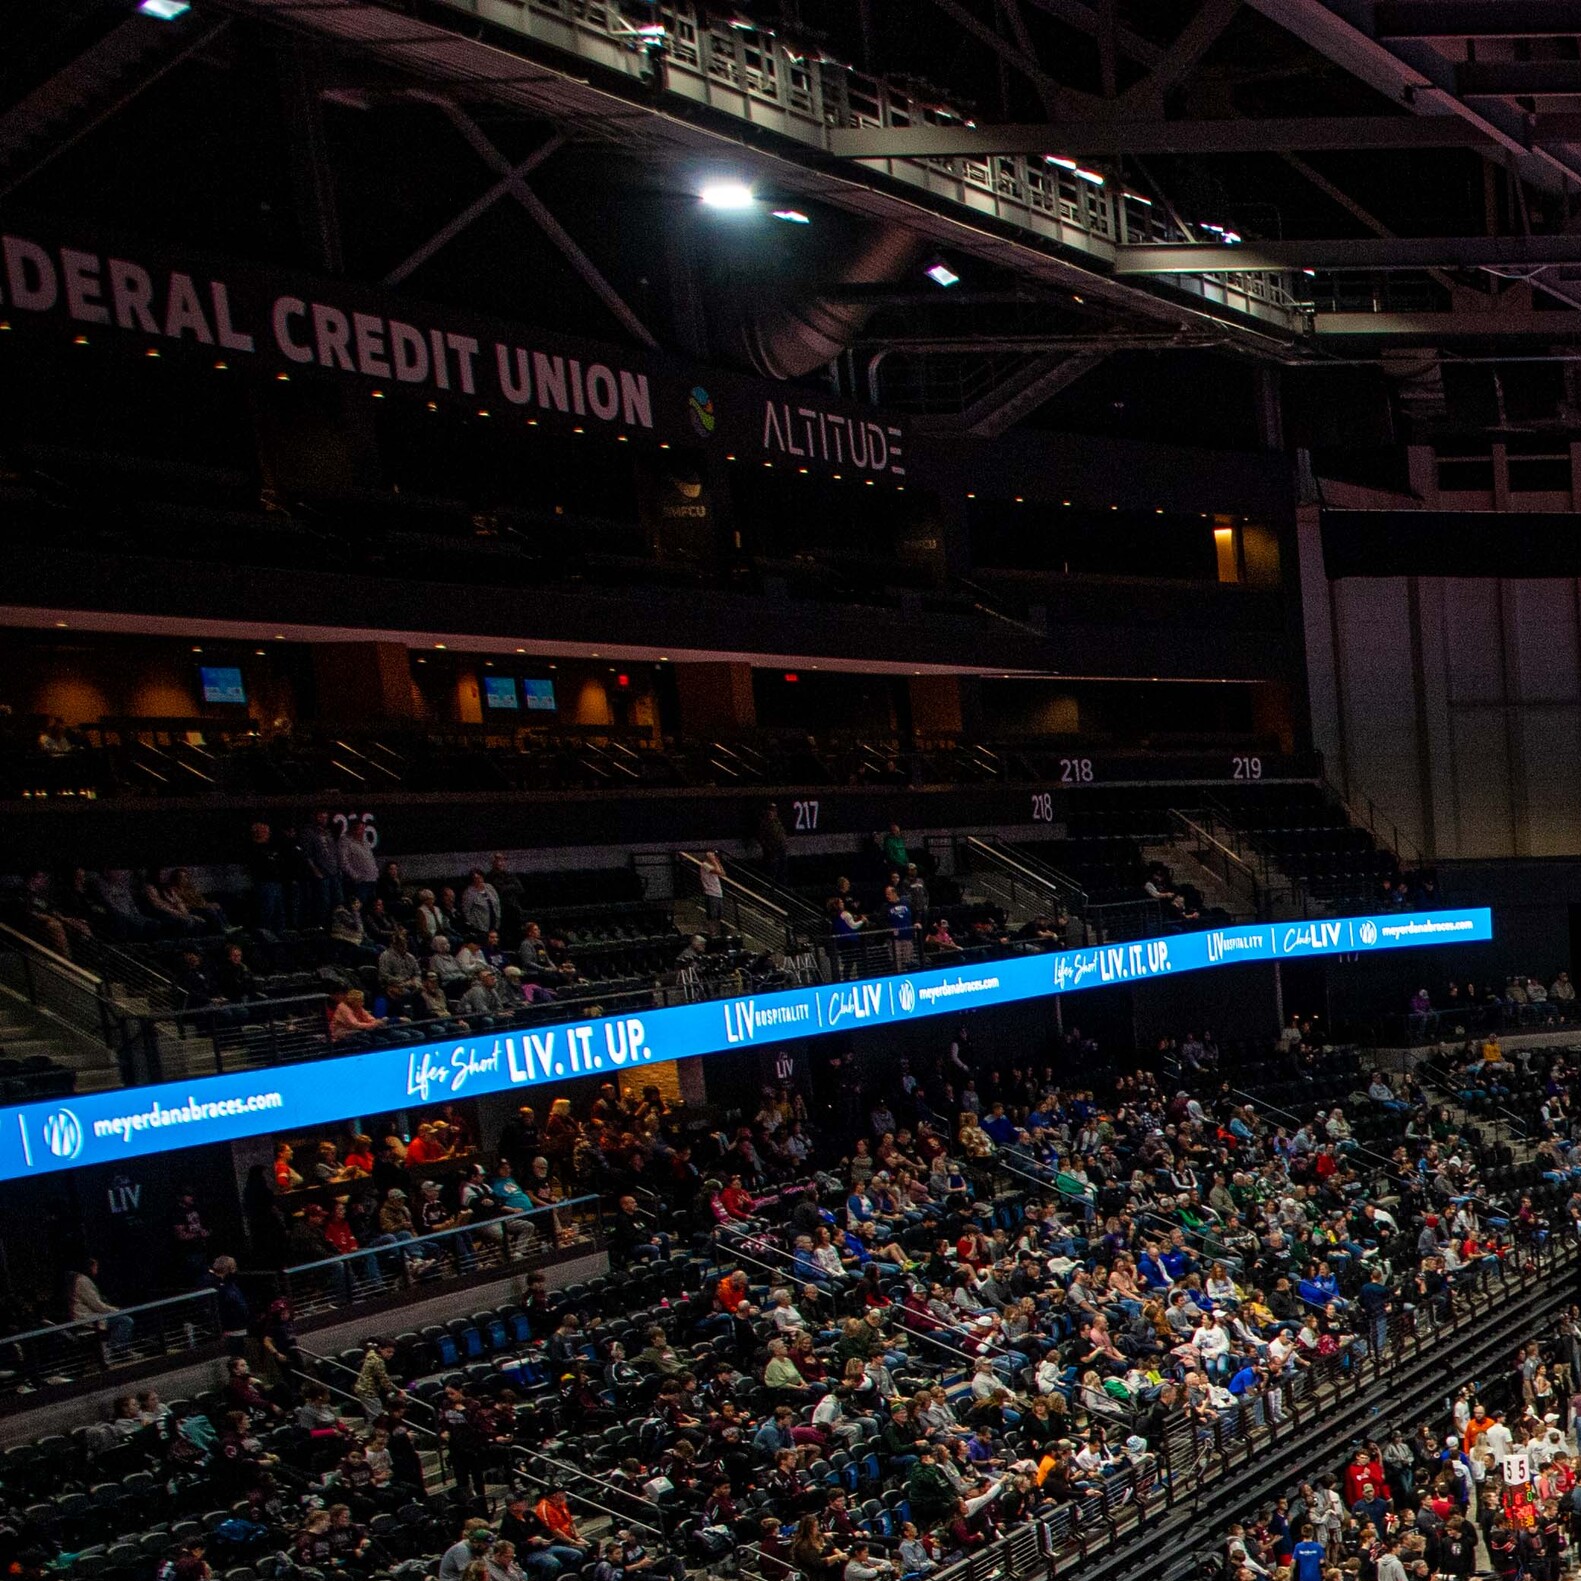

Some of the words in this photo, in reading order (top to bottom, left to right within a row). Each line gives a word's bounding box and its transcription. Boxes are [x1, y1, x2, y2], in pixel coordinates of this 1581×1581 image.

[271, 295, 481, 396] CREDIT
[494, 343, 654, 429] UNION
[763, 400, 906, 477] ALTITUDE
[1059, 757, 1094, 784] 218
[1232, 756, 1262, 780] 219
[794, 800, 819, 833] 217
[1031, 792, 1054, 823] 218
[1074, 951, 1097, 984] Short
[1100, 948, 1128, 981] LIV.
[1129, 944, 1147, 976] IT.
[1148, 941, 1171, 972] UP.
[919, 977, 999, 1005] meyerdanabraces.com
[407, 1051, 450, 1101] Life's
[451, 1039, 502, 1091] Short
[506, 1032, 564, 1083] LIV.
[567, 1026, 602, 1072] IT.
[605, 1019, 651, 1065] UP.
[94, 1091, 283, 1142] meyerdanabraces.com
